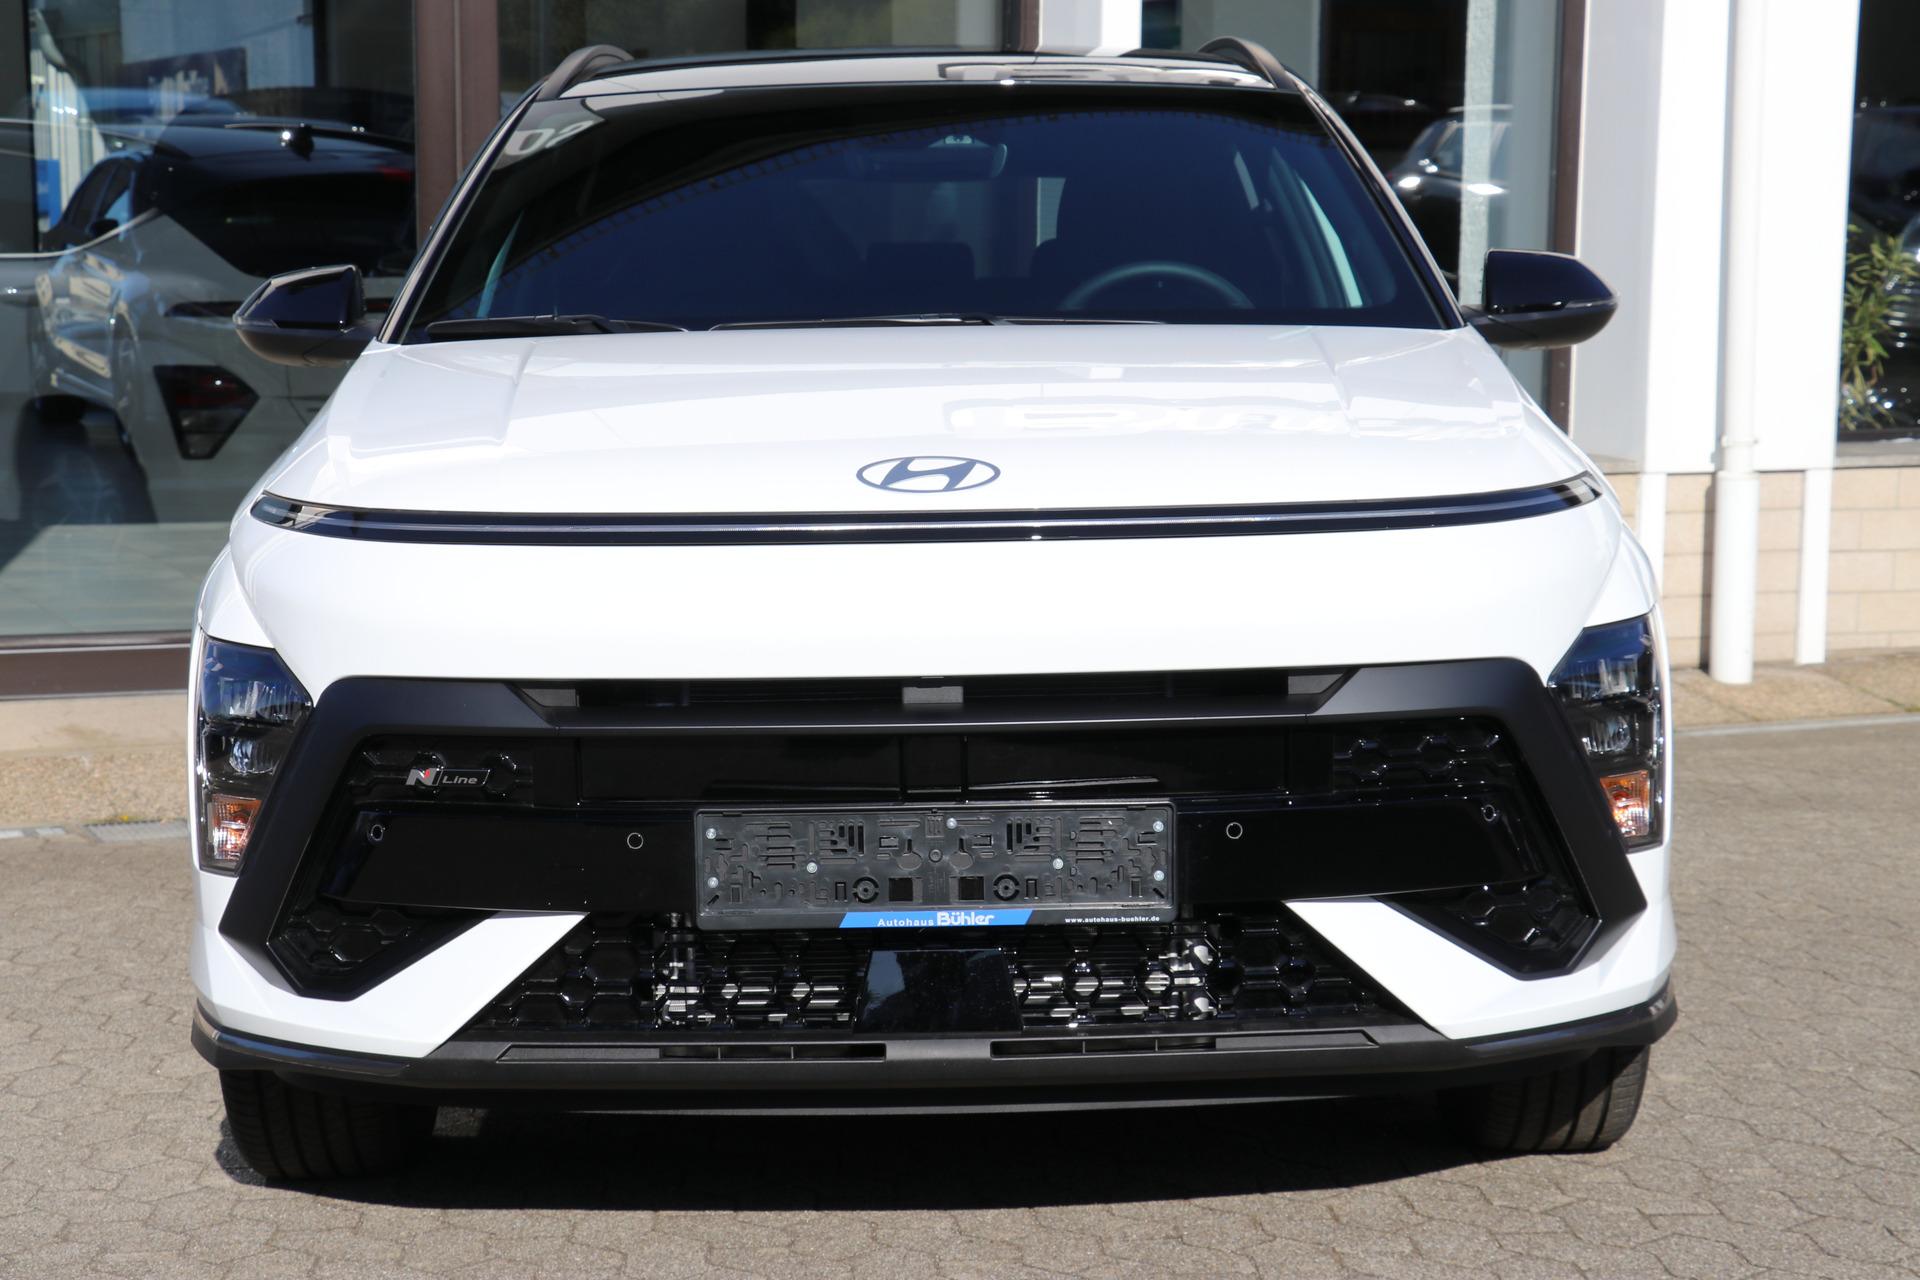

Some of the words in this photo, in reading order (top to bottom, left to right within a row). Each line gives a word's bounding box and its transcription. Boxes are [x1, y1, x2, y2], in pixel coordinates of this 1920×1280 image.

[406, 767, 437, 786] N
[442, 775, 478, 784] Line
[878, 918, 934, 928] Autohaus
[938, 912, 994, 927] Bühler
